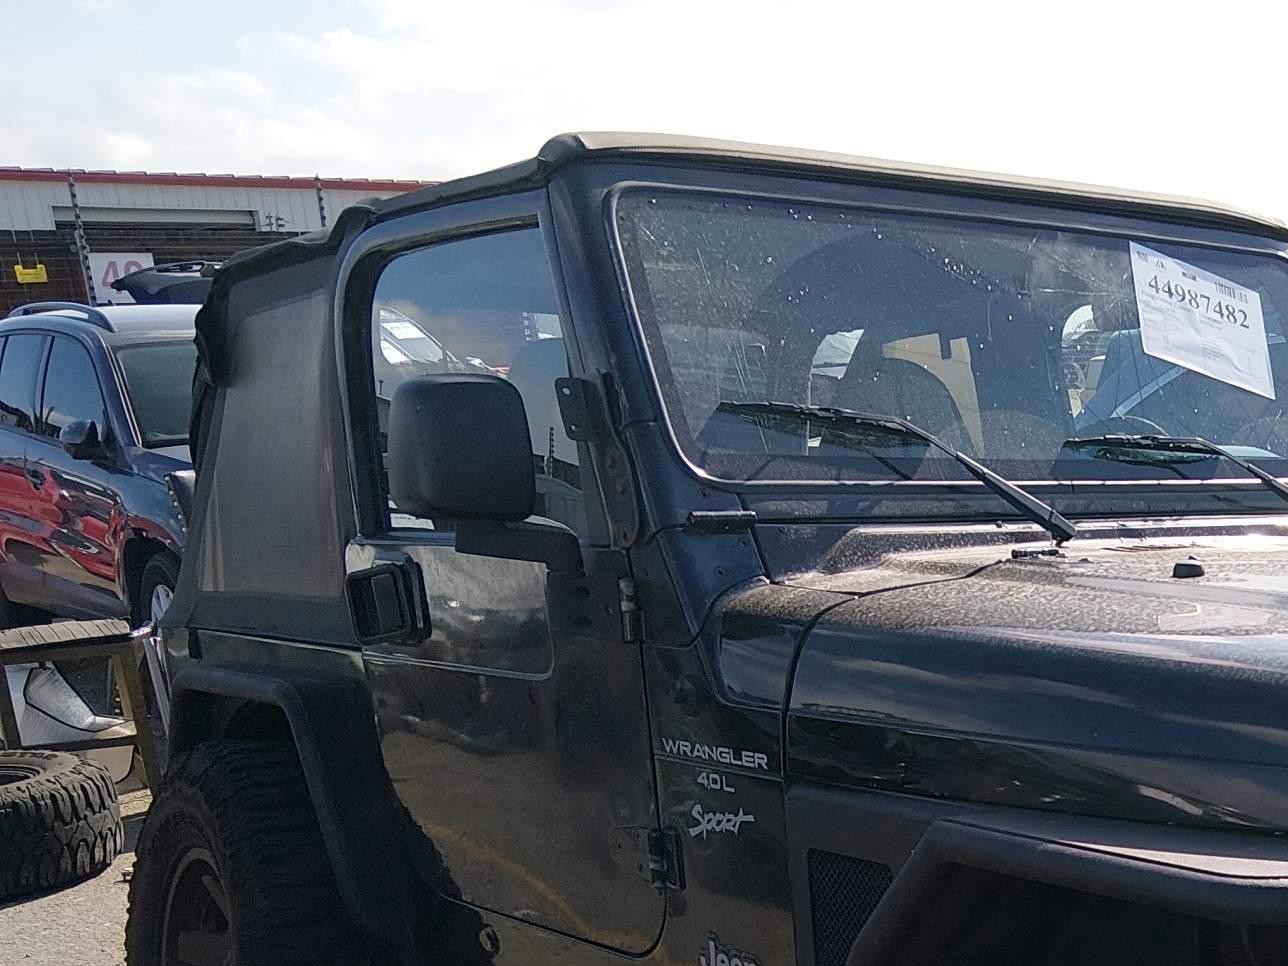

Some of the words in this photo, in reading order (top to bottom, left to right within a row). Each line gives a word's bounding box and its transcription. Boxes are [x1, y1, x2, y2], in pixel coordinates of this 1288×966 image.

[1148, 274, 1250, 329] 44987482
[661, 737, 768, 769] WRANGLER
[688, 804, 755, 839] Sport
